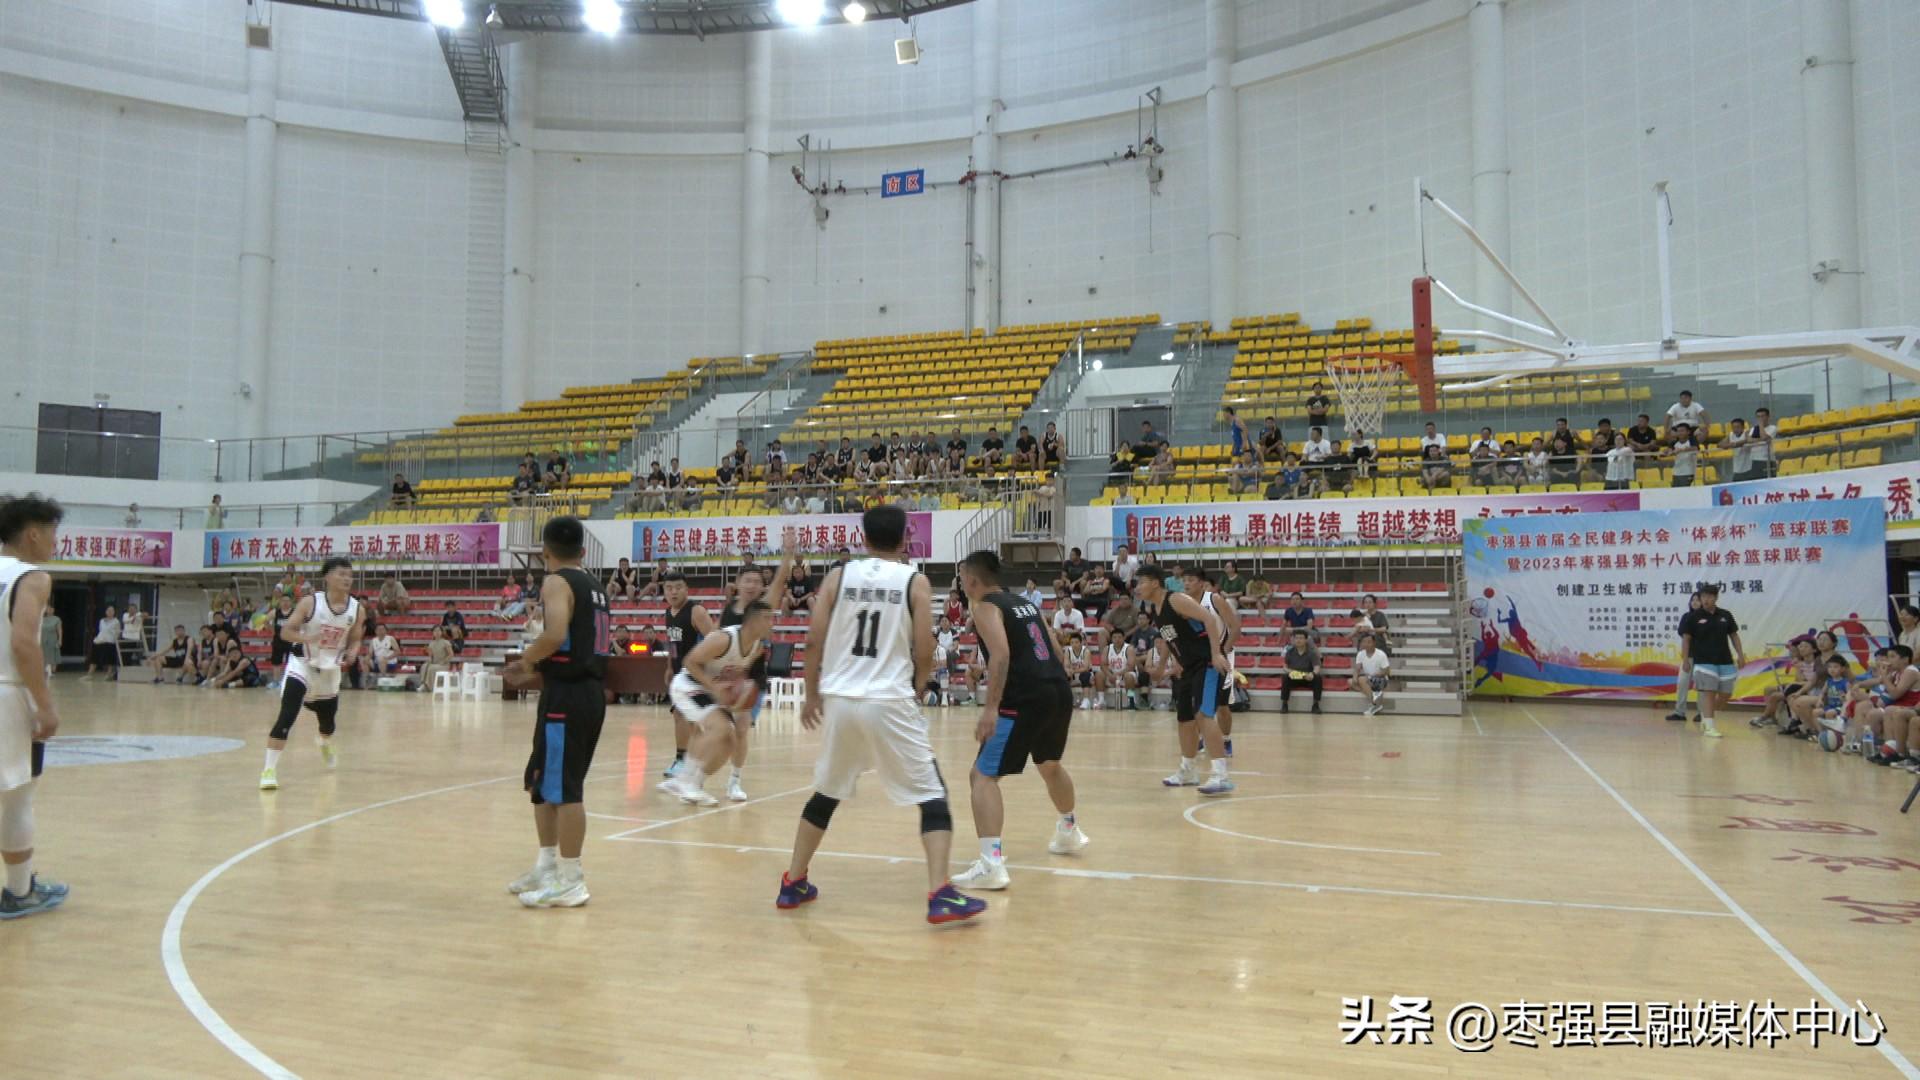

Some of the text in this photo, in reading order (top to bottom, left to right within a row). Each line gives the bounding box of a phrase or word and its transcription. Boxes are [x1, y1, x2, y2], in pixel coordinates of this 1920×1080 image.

[886, 174, 919, 194] 南区
[1887, 477, 1920, 515] 秀
[657, 525, 768, 553] 全民健身手牵手
[1142, 515, 1232, 544] 团结拼搏
[1248, 512, 1341, 542] 勇创佳绩
[1357, 508, 1458, 540] 超越梦想
[52, 534, 147, 560] 力枣强更精彩
[230, 534, 334, 559] 体育无处不在
[349, 532, 461, 557] 运动无限精彩
[1507, 547, 1822, 571] 暨2023年枣强县第十八届业余篮球联赛
[1556, 582, 1648, 597] 创建卫生城市
[852, 609, 880, 658] 11
[1026, 622, 1050, 661] 3
